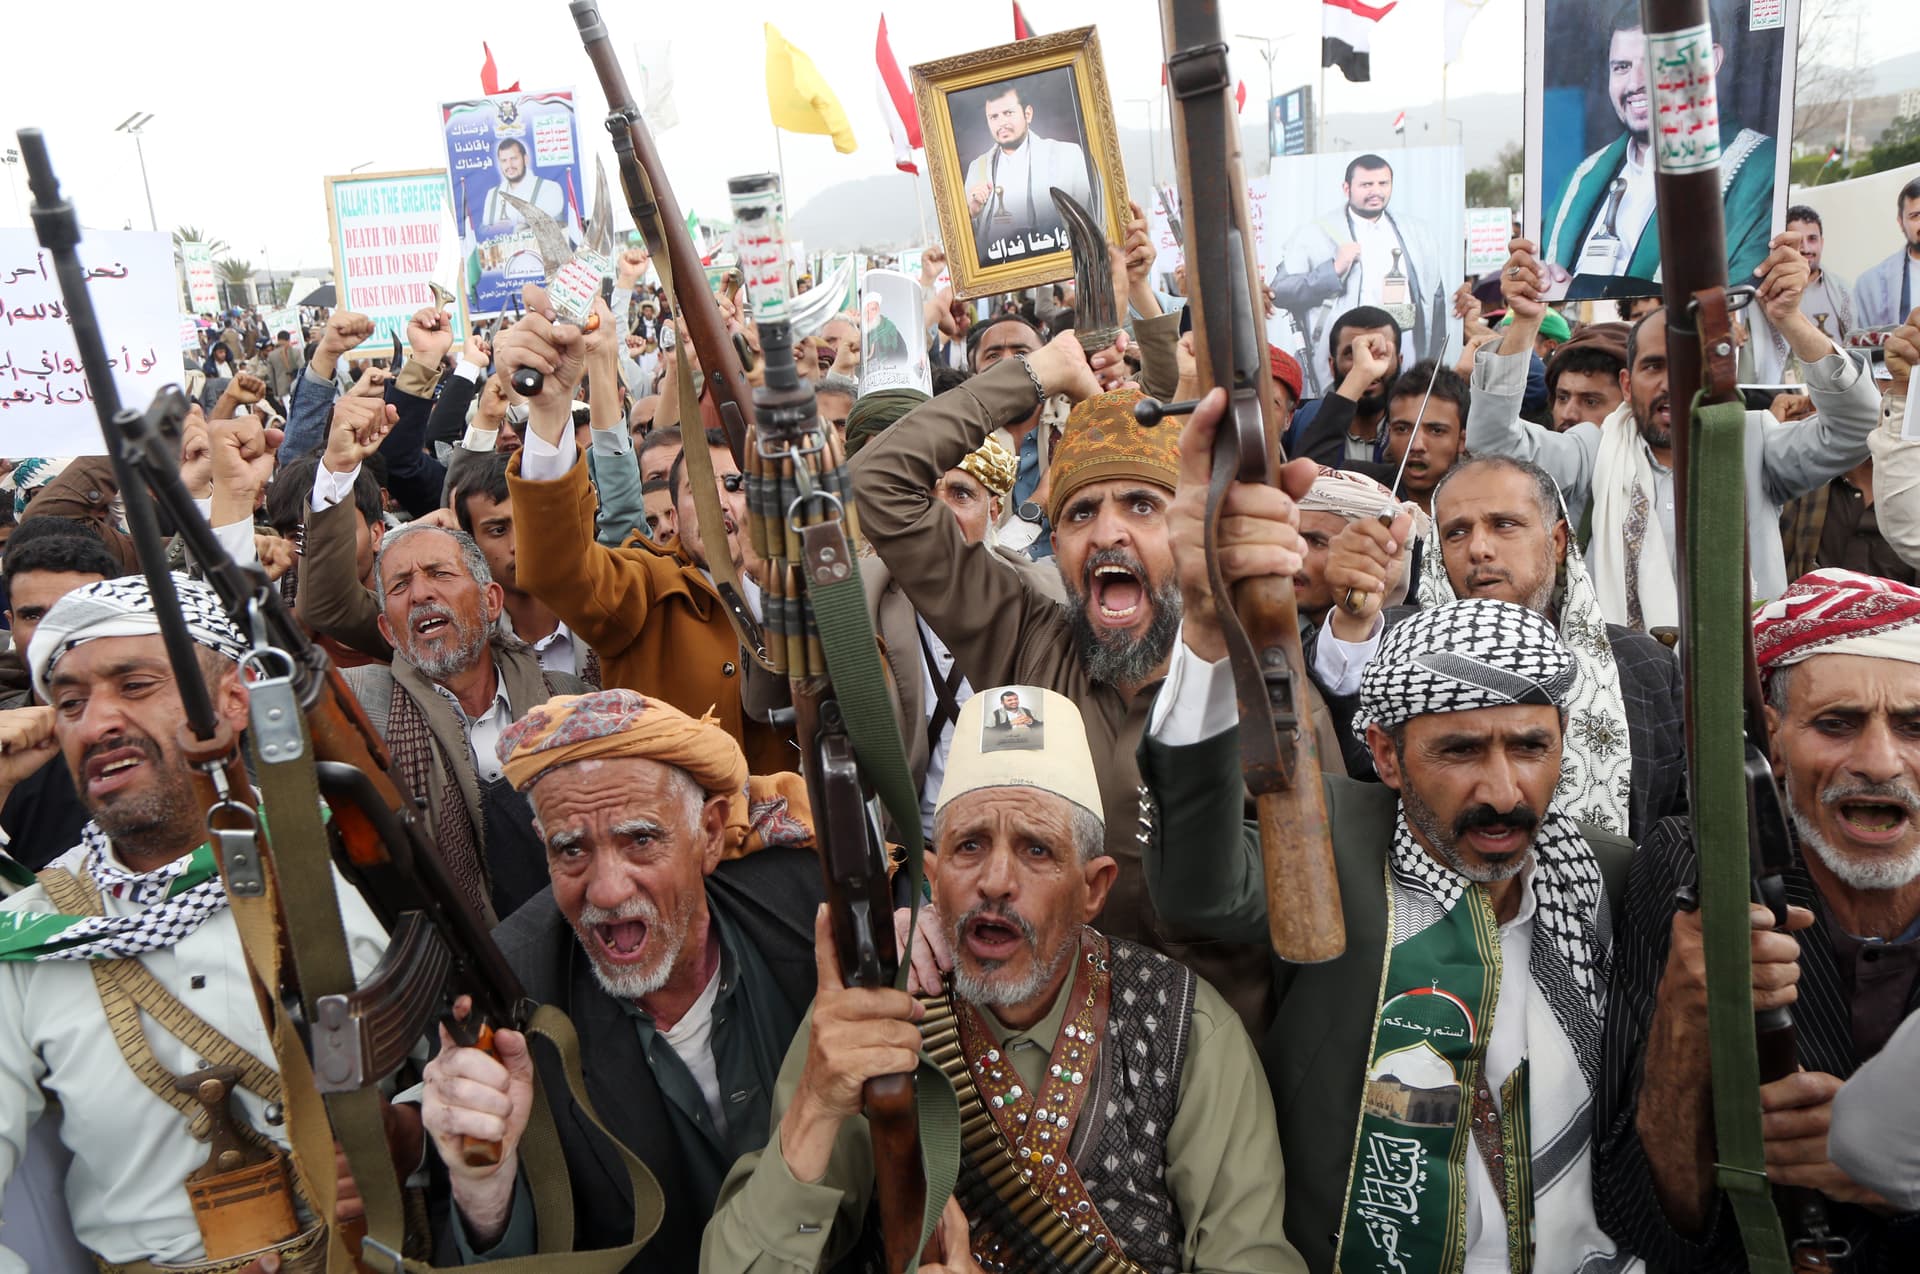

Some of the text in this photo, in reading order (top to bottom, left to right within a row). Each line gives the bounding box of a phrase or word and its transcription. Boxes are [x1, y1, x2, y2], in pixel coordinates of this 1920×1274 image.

[341, 188, 368, 217] ALLAH
[371, 188, 380, 214] IS
[381, 187, 400, 214] THE
[345, 224, 441, 249] DEATH TO AMERIC
[0, 252, 48, 284] أحر
[348, 254, 383, 277] DEATH
[385, 254, 400, 274] TO
[351, 286, 380, 308] CURSE
[381, 284, 406, 306] UPON
[407, 283, 427, 304] THE
[367, 315, 403, 341] TORY
[136, 348, 157, 374] لو
[0, 388, 36, 409] نعب
[1383, 1017, 1465, 1037] لستم وحدكم
